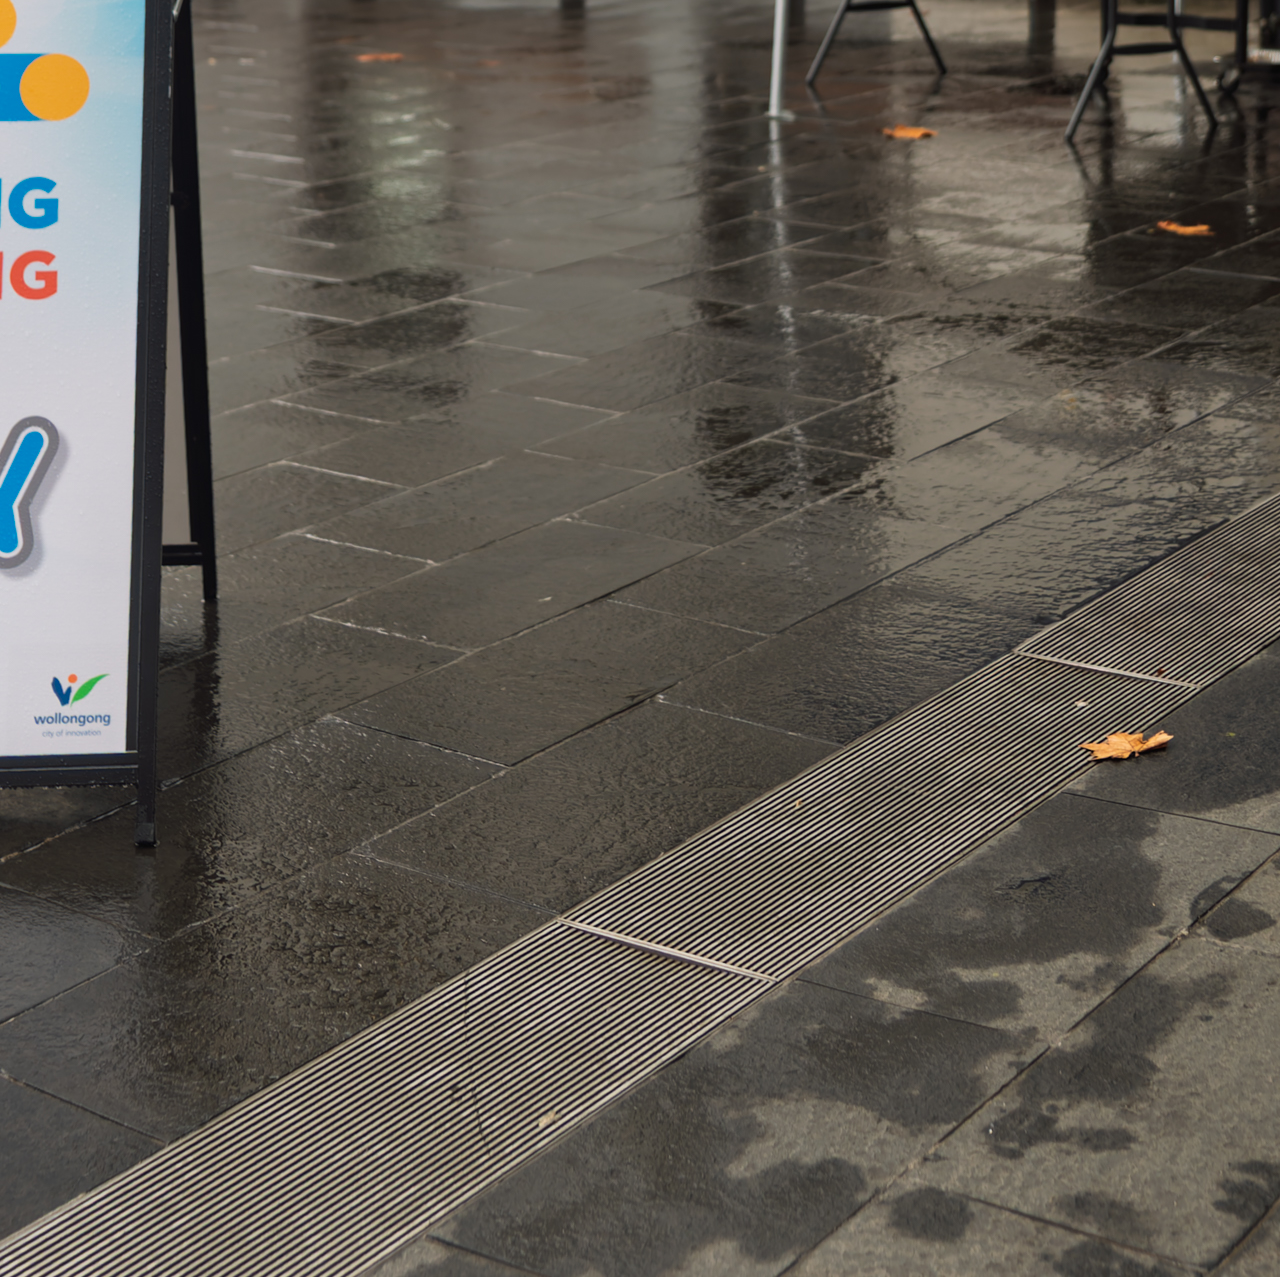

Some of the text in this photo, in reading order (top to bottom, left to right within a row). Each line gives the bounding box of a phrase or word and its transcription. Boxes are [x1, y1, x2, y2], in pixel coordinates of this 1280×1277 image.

[33, 712, 111, 727] wollongong
[42, 728, 102, 739] city of innovation
